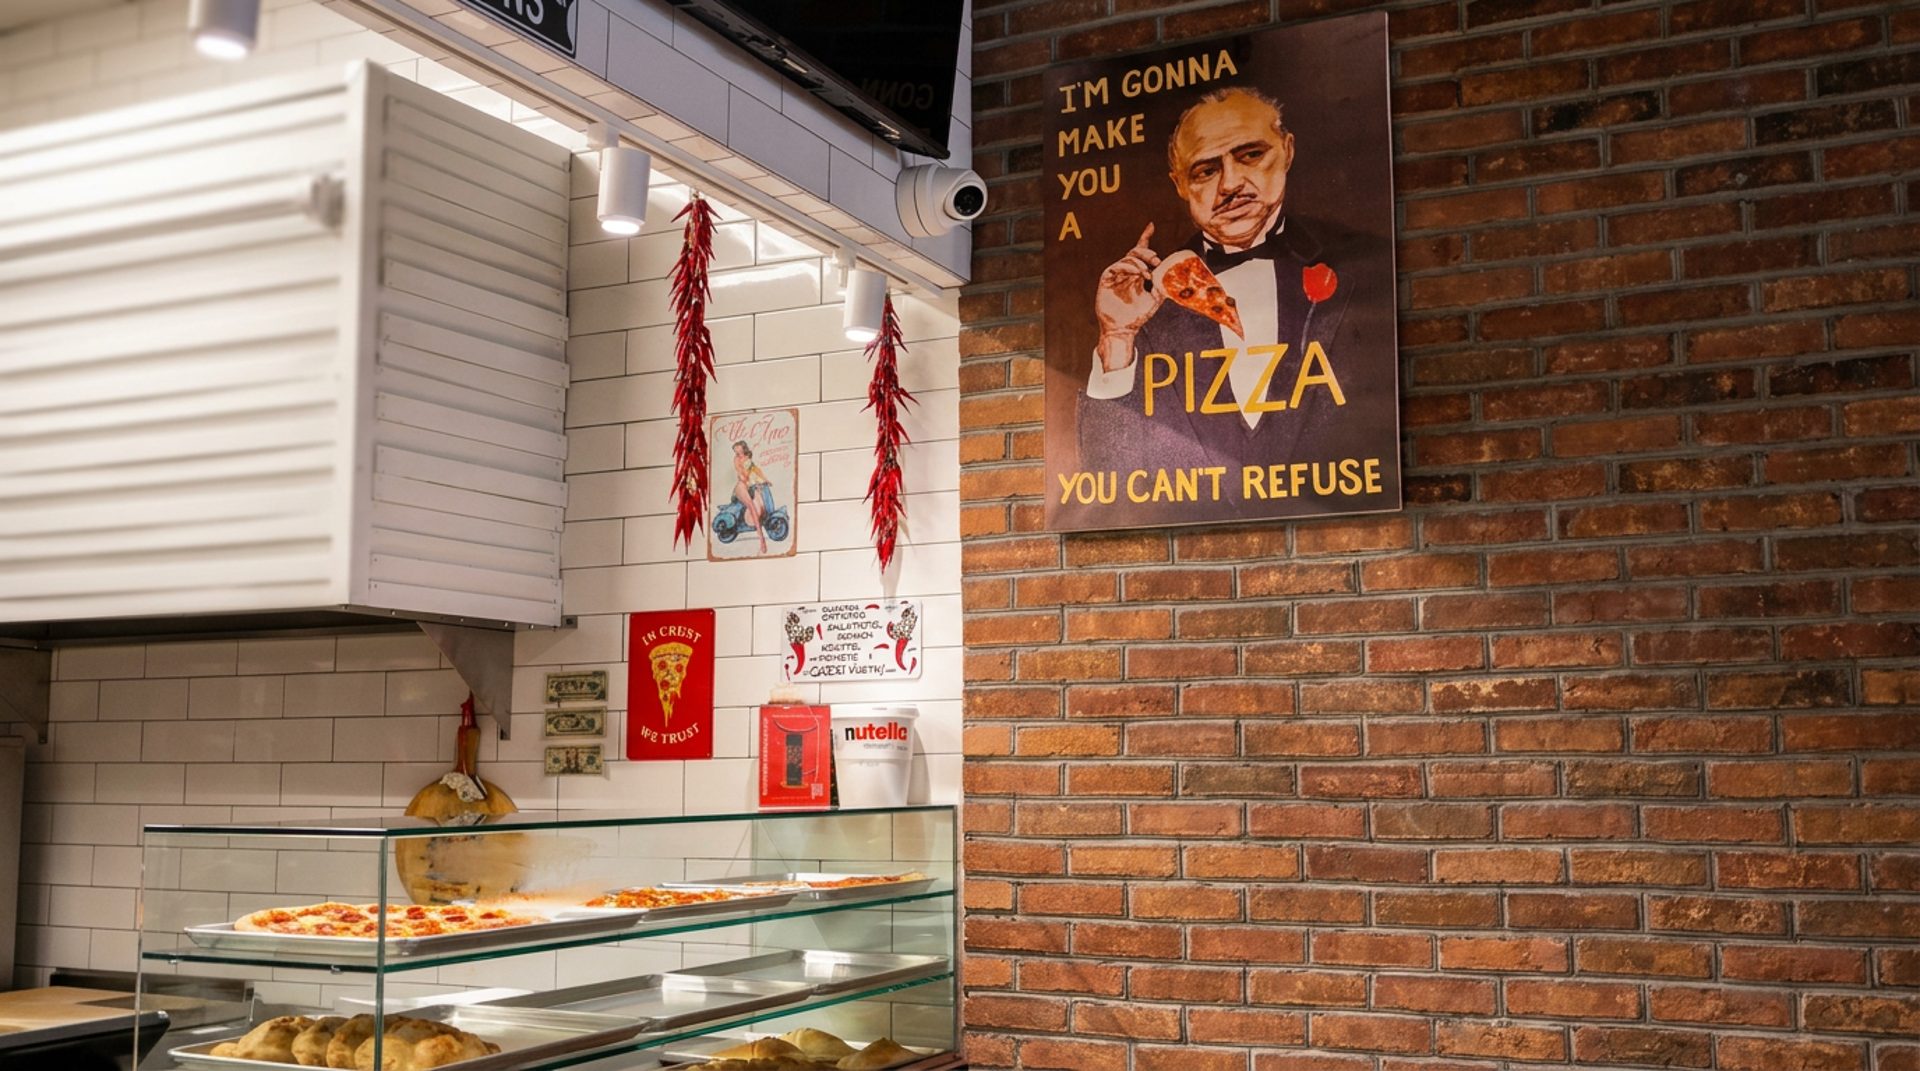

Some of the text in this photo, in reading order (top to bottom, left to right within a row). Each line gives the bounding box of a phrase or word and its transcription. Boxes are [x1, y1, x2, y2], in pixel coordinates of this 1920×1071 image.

[1059, 49, 1239, 113] I'M GONNA
[1058, 113, 1145, 157] MAKE
[1057, 164, 1120, 200] YOU
[1059, 211, 1082, 241] A
[1144, 341, 1346, 417] PIZZA
[1058, 458, 1382, 505] YOU CAN'T REFUSE
[660, 721, 700, 744] TRUST
